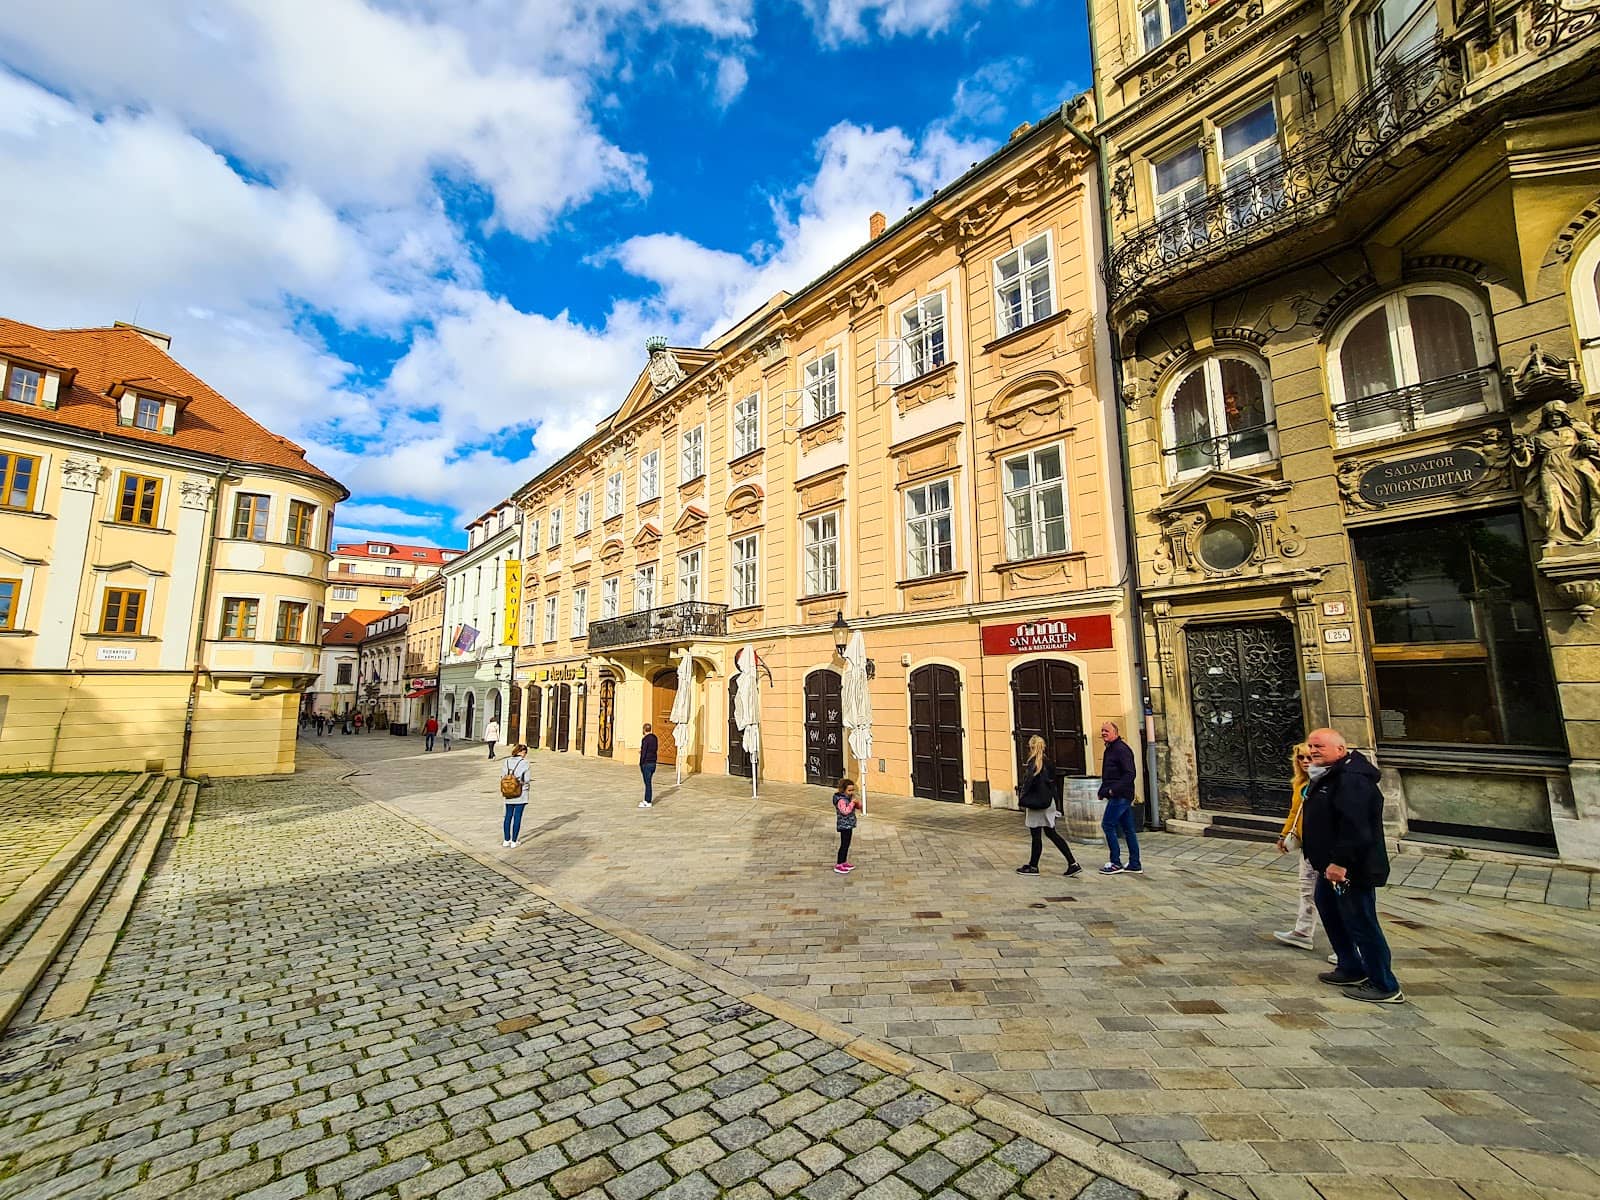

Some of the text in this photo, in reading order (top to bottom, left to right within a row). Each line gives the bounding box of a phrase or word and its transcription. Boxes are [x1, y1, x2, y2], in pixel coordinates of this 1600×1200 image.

[1384, 456, 1455, 478] SALVATOR
[1009, 632, 1077, 647] SAN MARTEN
